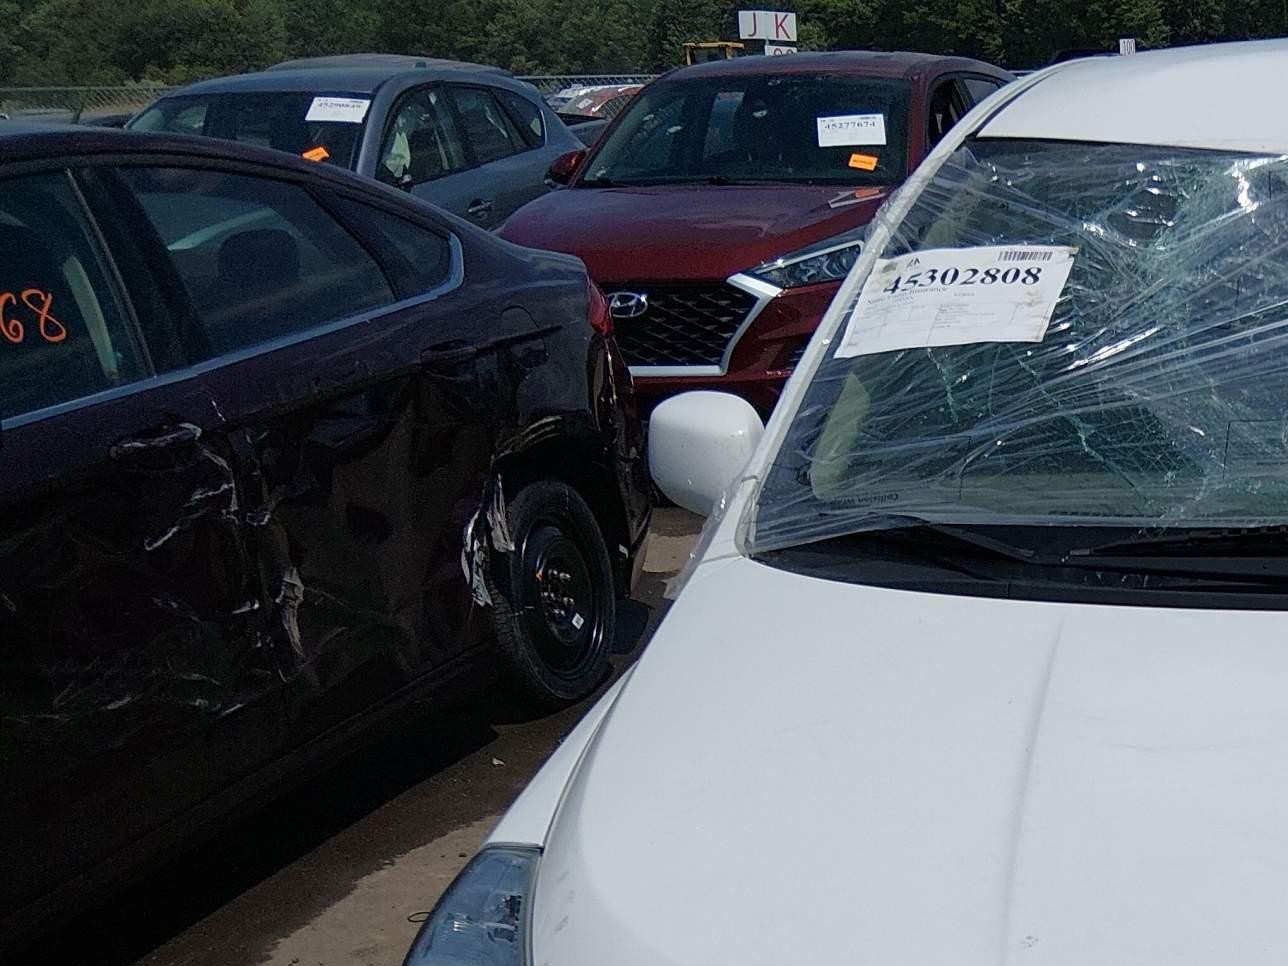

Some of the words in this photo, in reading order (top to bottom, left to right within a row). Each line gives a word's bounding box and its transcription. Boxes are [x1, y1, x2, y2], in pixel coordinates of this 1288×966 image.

[747, 12, 757, 37] J
[775, 13, 791, 40] K
[883, 267, 1043, 295] 45302808
